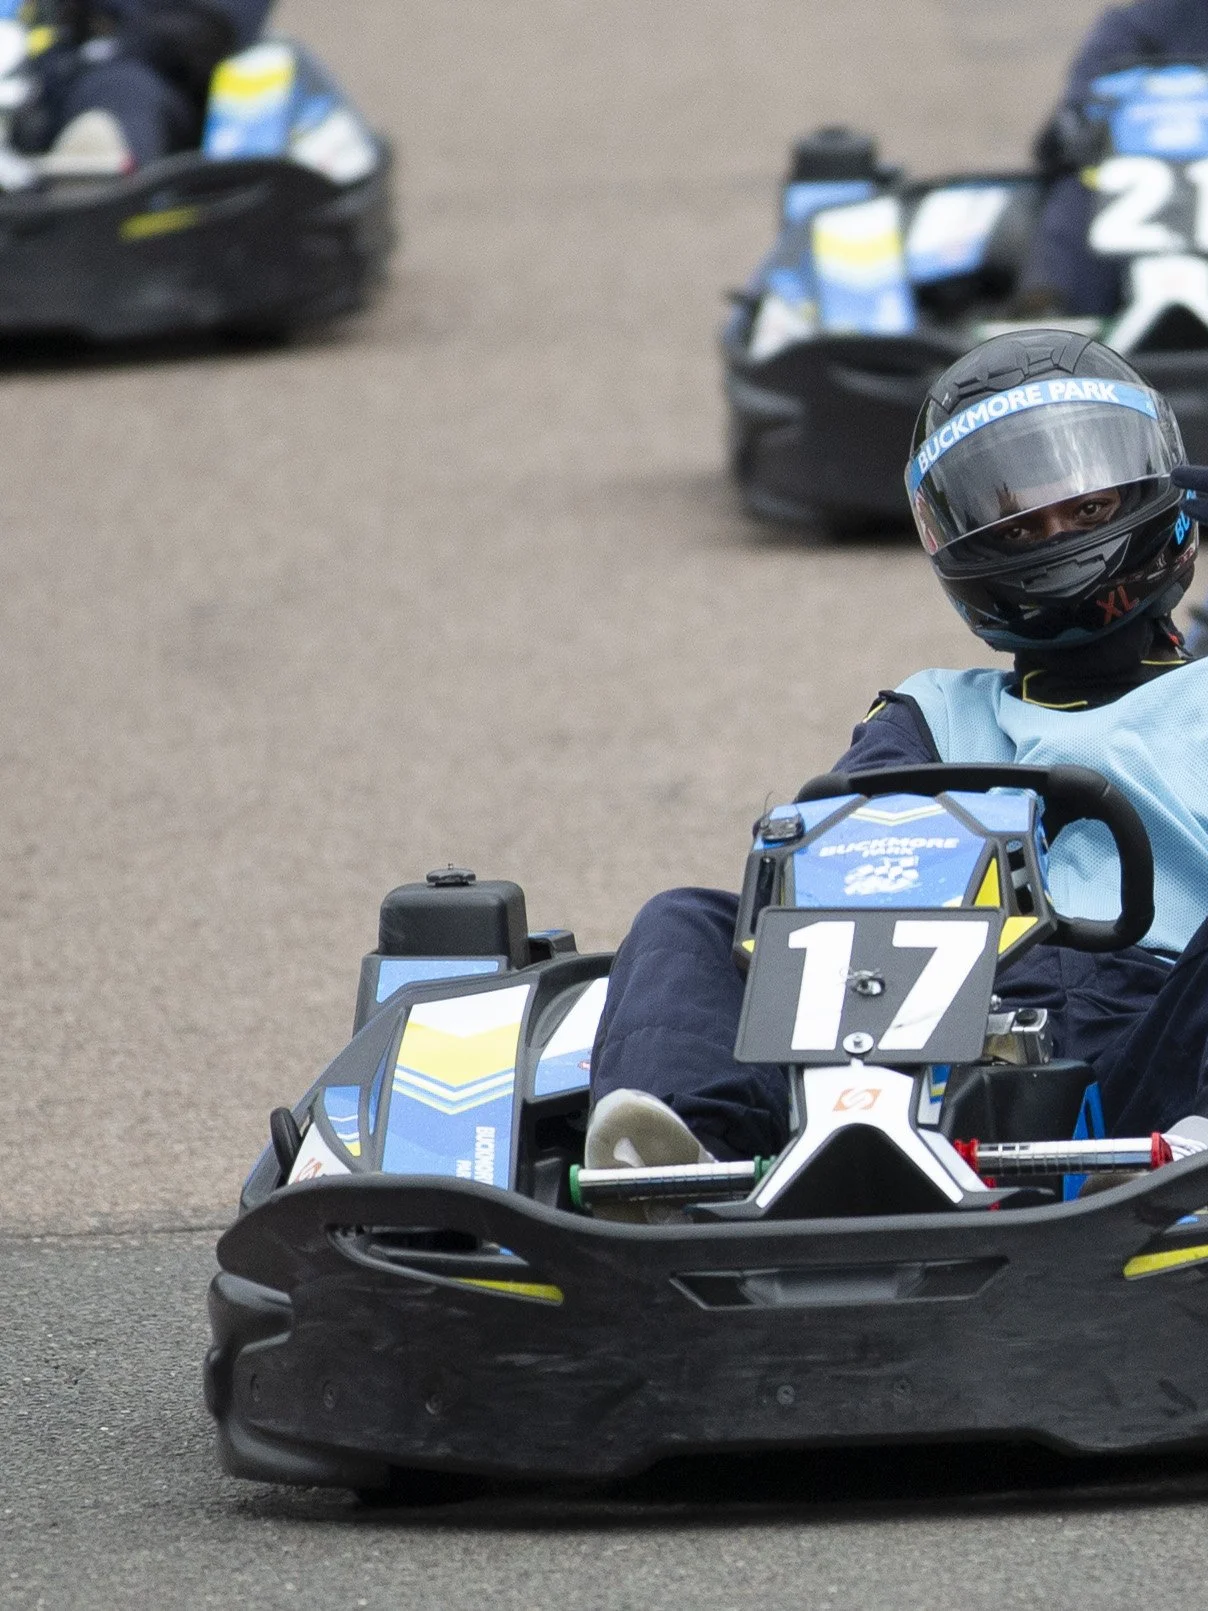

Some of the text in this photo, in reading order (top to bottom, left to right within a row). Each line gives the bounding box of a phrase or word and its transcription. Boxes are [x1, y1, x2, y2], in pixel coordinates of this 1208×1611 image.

[917, 380, 1120, 474] BUCKMORE PARK
[1096, 585, 1140, 624] XL
[788, 920, 990, 1050] 17
